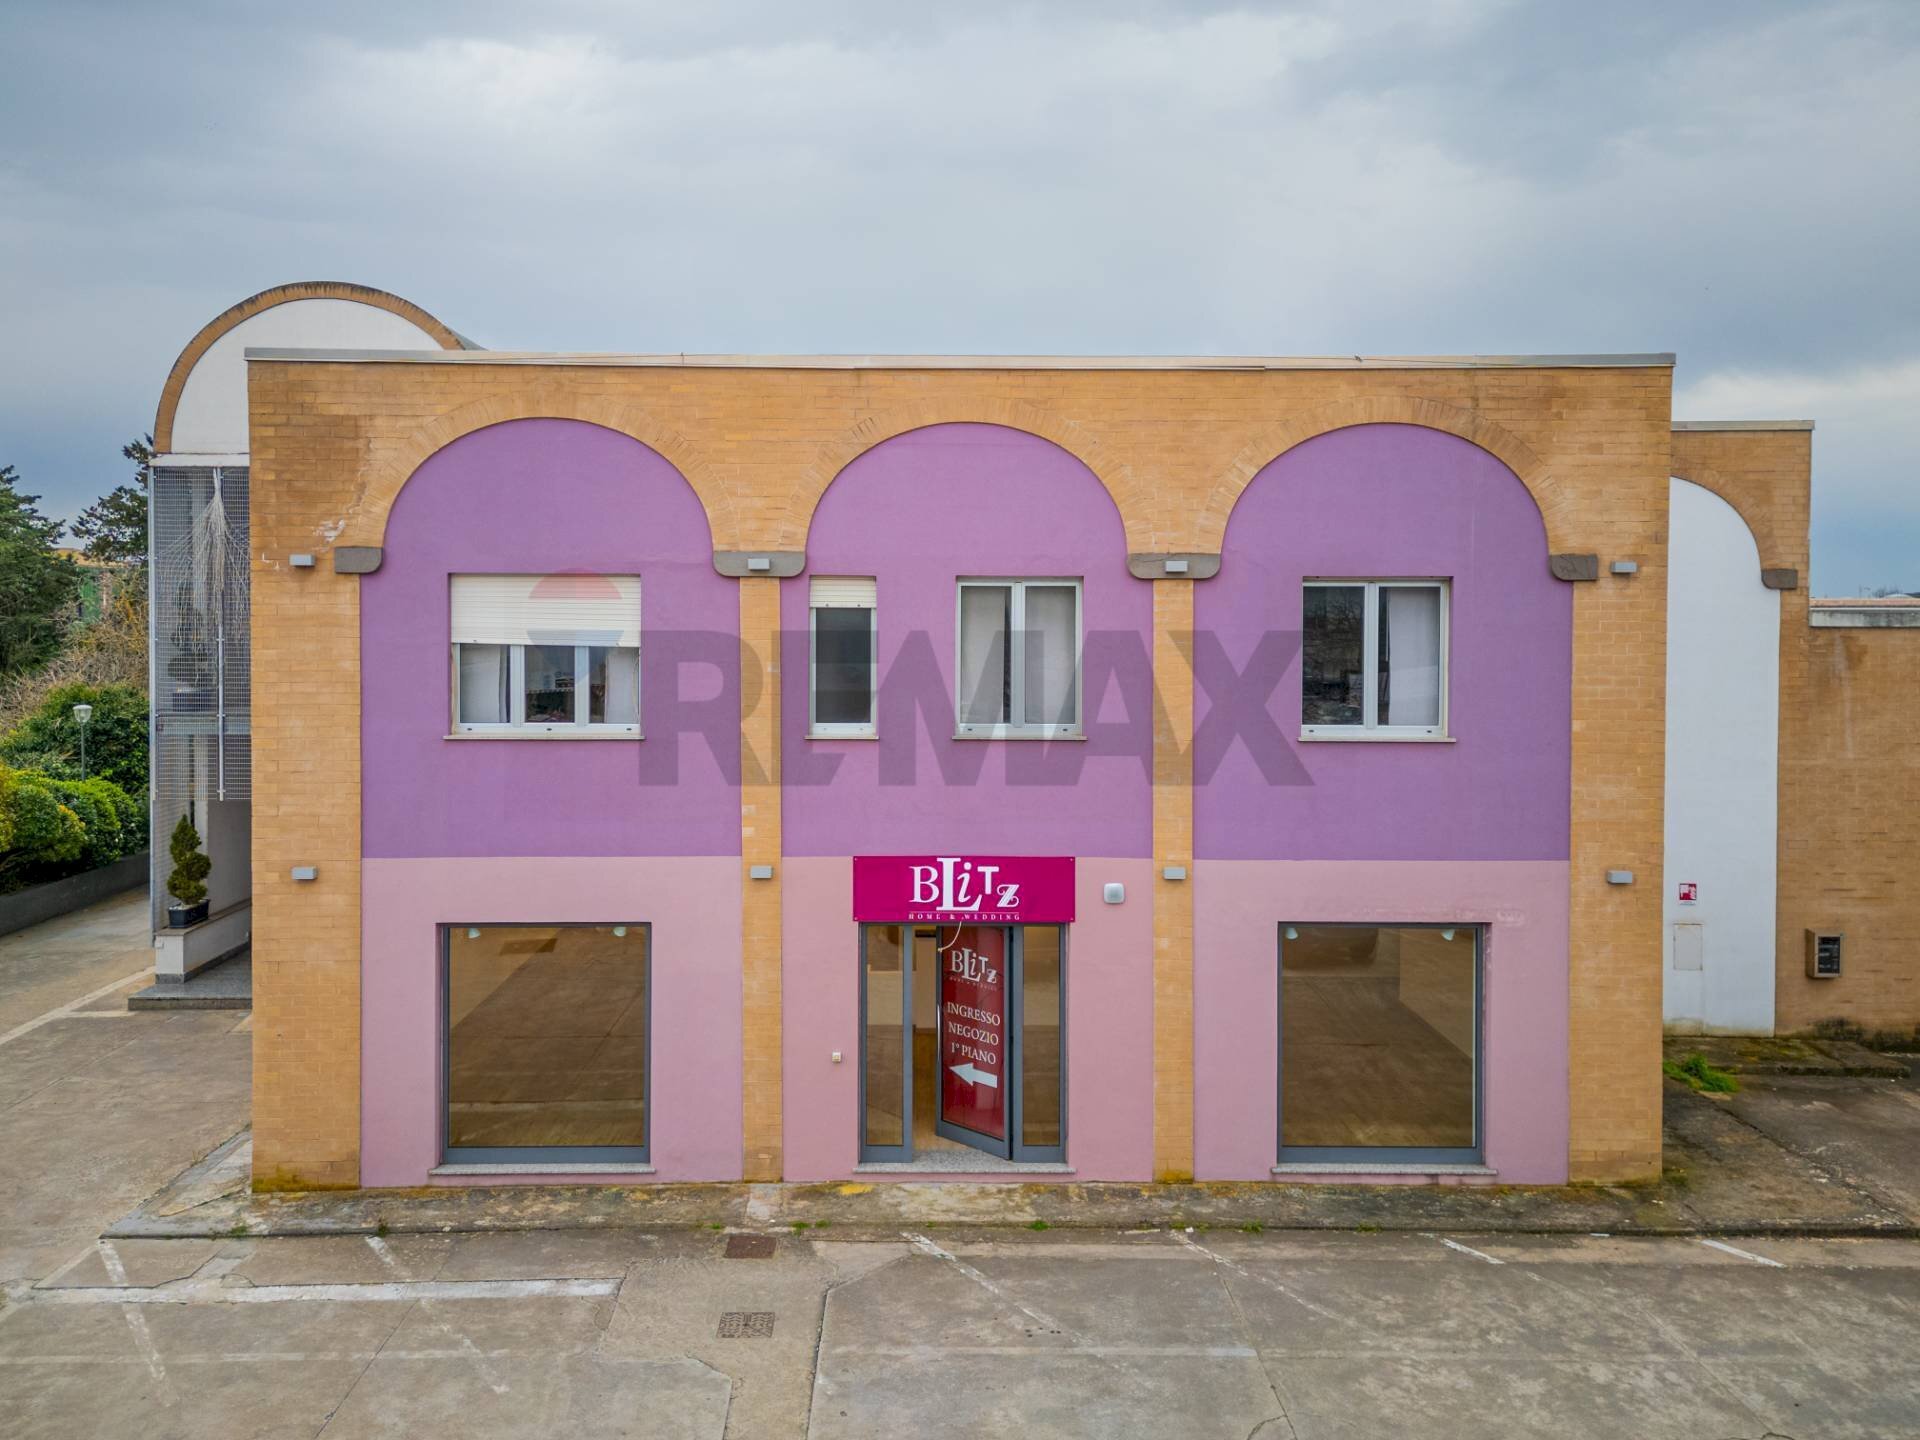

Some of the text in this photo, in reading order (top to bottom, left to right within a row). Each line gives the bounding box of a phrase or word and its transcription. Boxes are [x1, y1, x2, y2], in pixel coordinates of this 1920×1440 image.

[964, 913, 1020, 921] WEDDING
[947, 1001, 1001, 1026] INGRESSO
[948, 1020, 999, 1047] NEGOZIO
[961, 1044, 997, 1066] PIANO
